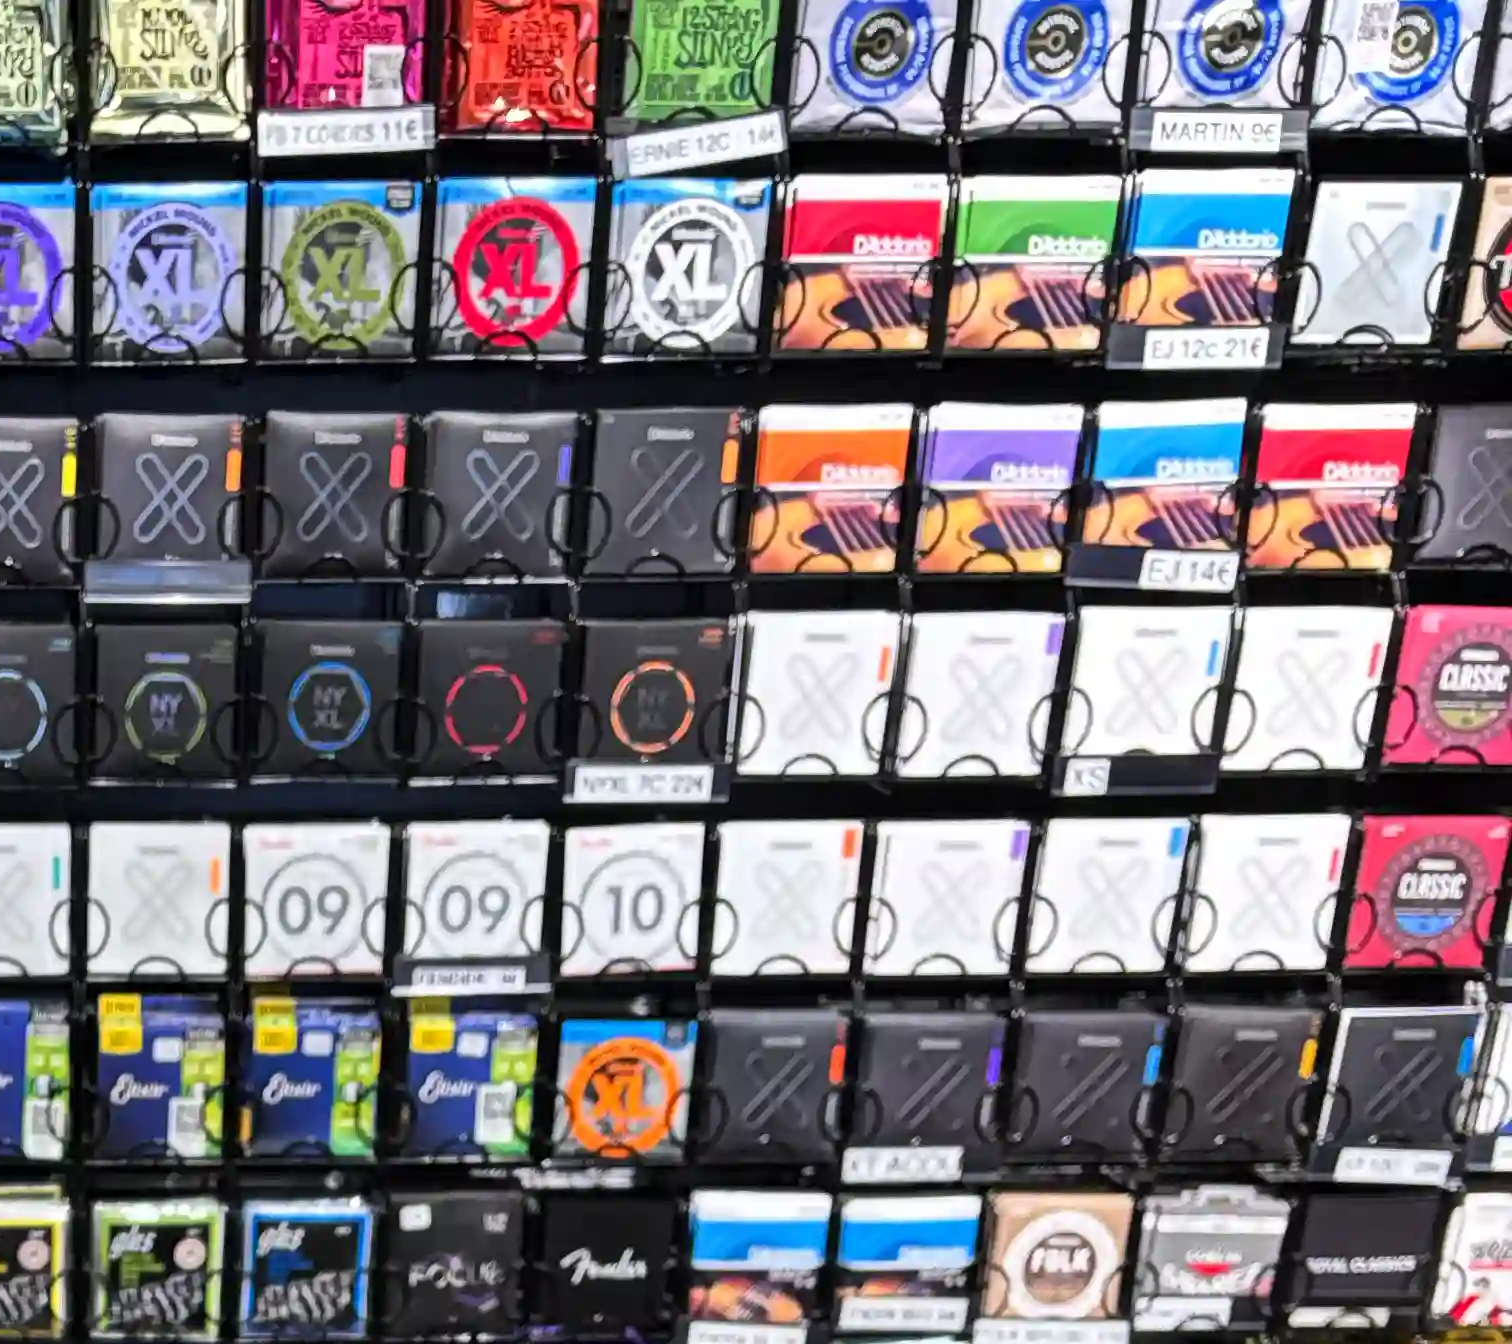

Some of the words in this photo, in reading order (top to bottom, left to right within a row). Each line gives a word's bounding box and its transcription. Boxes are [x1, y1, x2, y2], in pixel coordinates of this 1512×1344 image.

[382, 119, 421, 141] 11€
[1160, 122, 1244, 142] MARTIN
[1252, 122, 1277, 143] 9€
[136, 246, 209, 304] XL
[309, 246, 384, 302] XL
[479, 243, 552, 299] XL
[650, 243, 728, 301] XL
[1152, 340, 1174, 360] EJ
[1224, 338, 1261, 358] 21€
[1149, 558, 1181, 581] EJ
[1188, 559, 1232, 584] 14€
[1438, 661, 1510, 693] CLASSIC
[278, 885, 349, 935] 09
[438, 884, 509, 934] 09
[604, 883, 664, 934] 10
[1398, 871, 1468, 903] CLASSIC
[589, 1070, 656, 1119] XL
[559, 1246, 649, 1286] Fender
